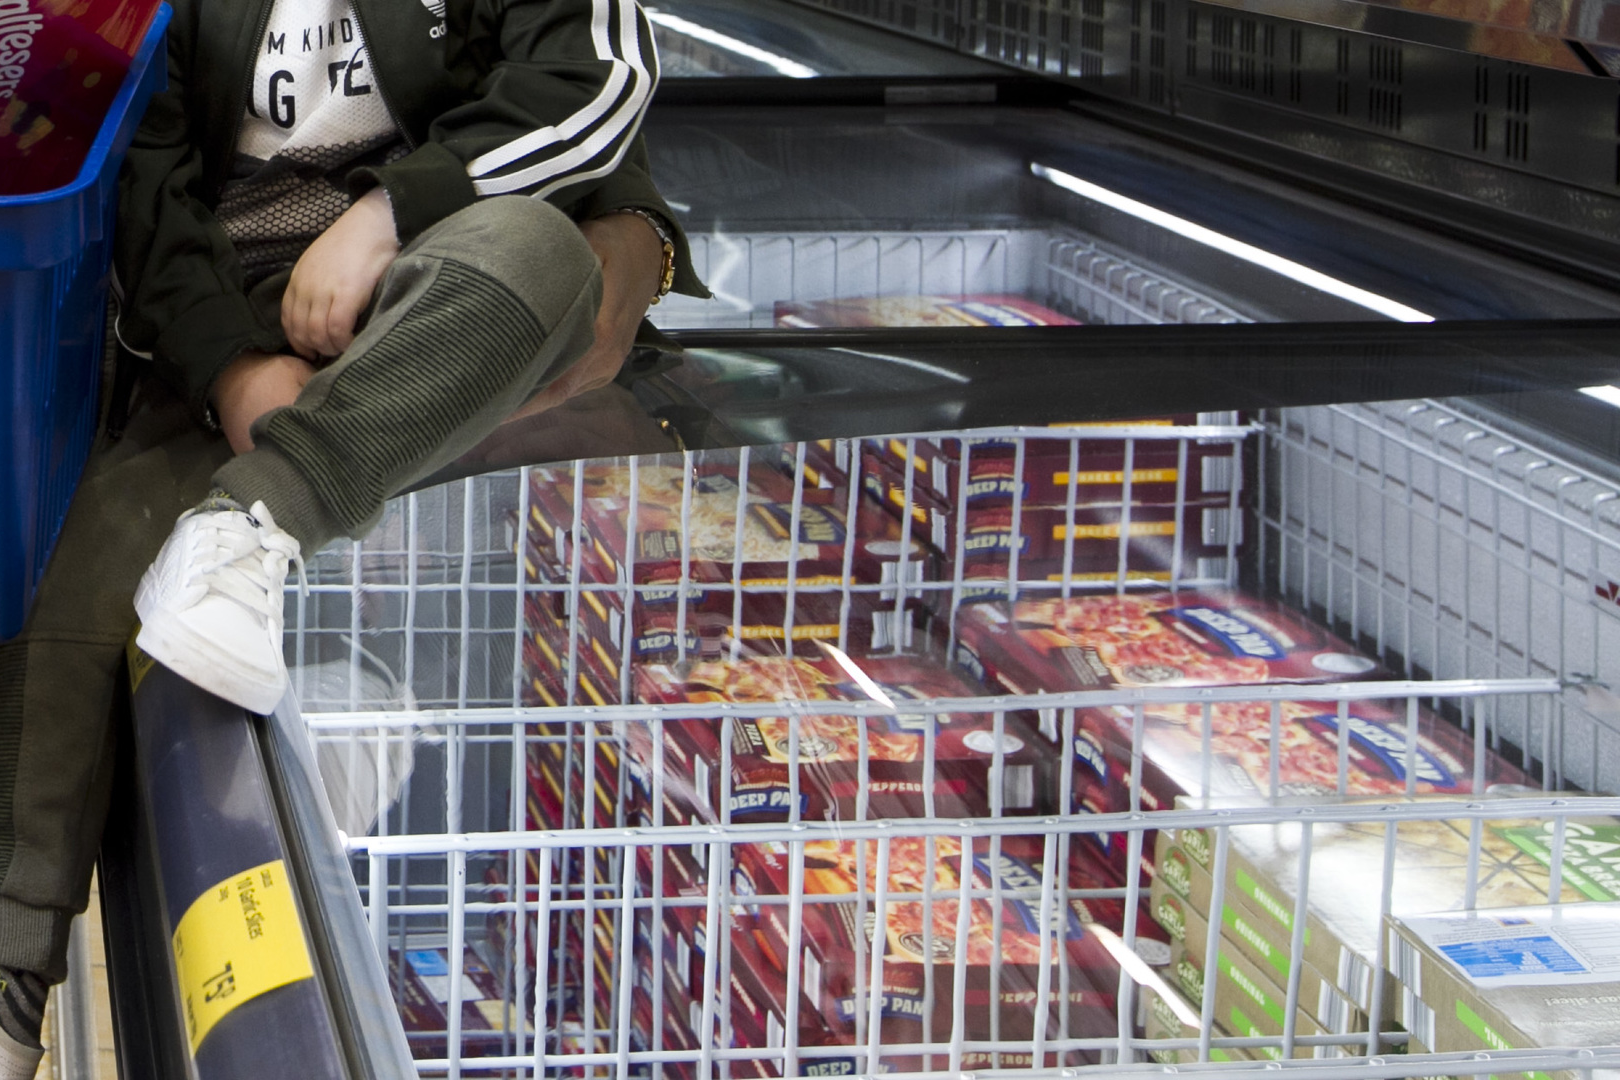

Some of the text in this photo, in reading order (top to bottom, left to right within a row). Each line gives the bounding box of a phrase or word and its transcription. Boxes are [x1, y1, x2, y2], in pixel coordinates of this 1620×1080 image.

[267, 31, 286, 55] M
[639, 637, 671, 651] DEEP
[744, 723, 763, 746] PIZZA
[868, 782, 926, 792] PEPPERO
[730, 791, 791, 811] DEEP PA
[239, 888, 261, 916] Garlic
[245, 911, 266, 940] Slices
[1230, 966, 1266, 1006] ORIGINAL
